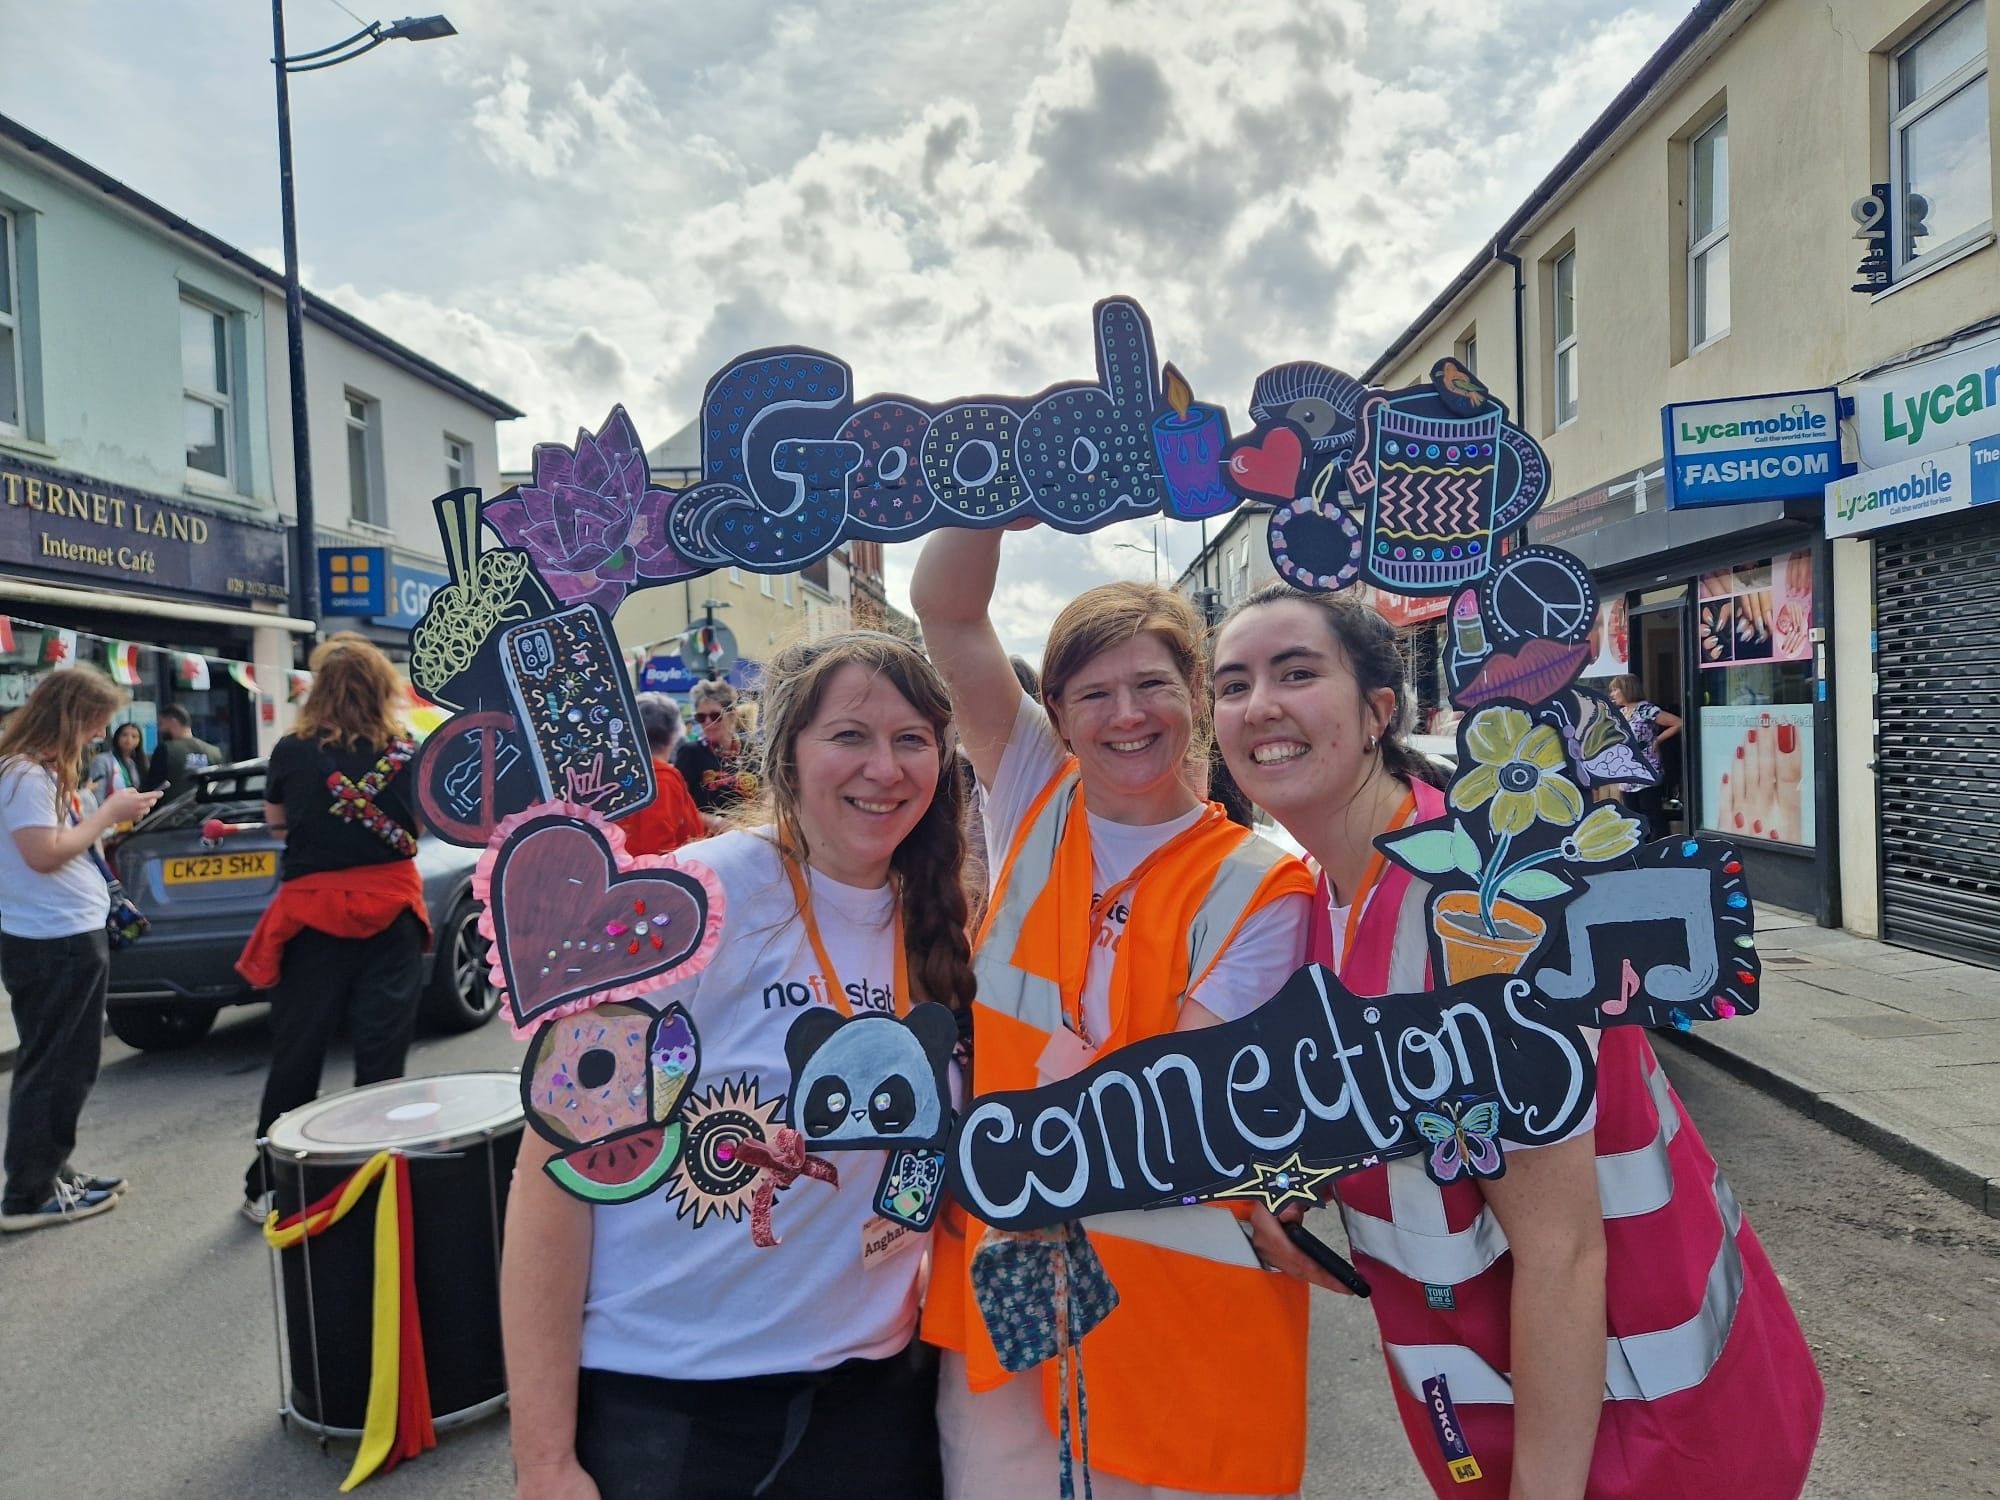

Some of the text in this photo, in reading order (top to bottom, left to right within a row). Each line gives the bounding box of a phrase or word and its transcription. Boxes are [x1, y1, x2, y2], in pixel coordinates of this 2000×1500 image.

[702, 300, 1163, 567] Good
[1681, 409, 1827, 444] Lycamobile
[1754, 434, 1769, 443] Call
[1685, 453, 1829, 486] FASHCOM
[1975, 448, 2000, 465] The
[3, 472, 208, 545] TERNET LAND
[1836, 469, 1952, 521] Lycamobile
[41, 531, 156, 574] Internet Café
[401, 579, 438, 616] GR
[173, 854, 266, 879] CK23 SHX
[845, 977, 896, 1014] stat
[1431, 1384, 1457, 1442] YOKO
